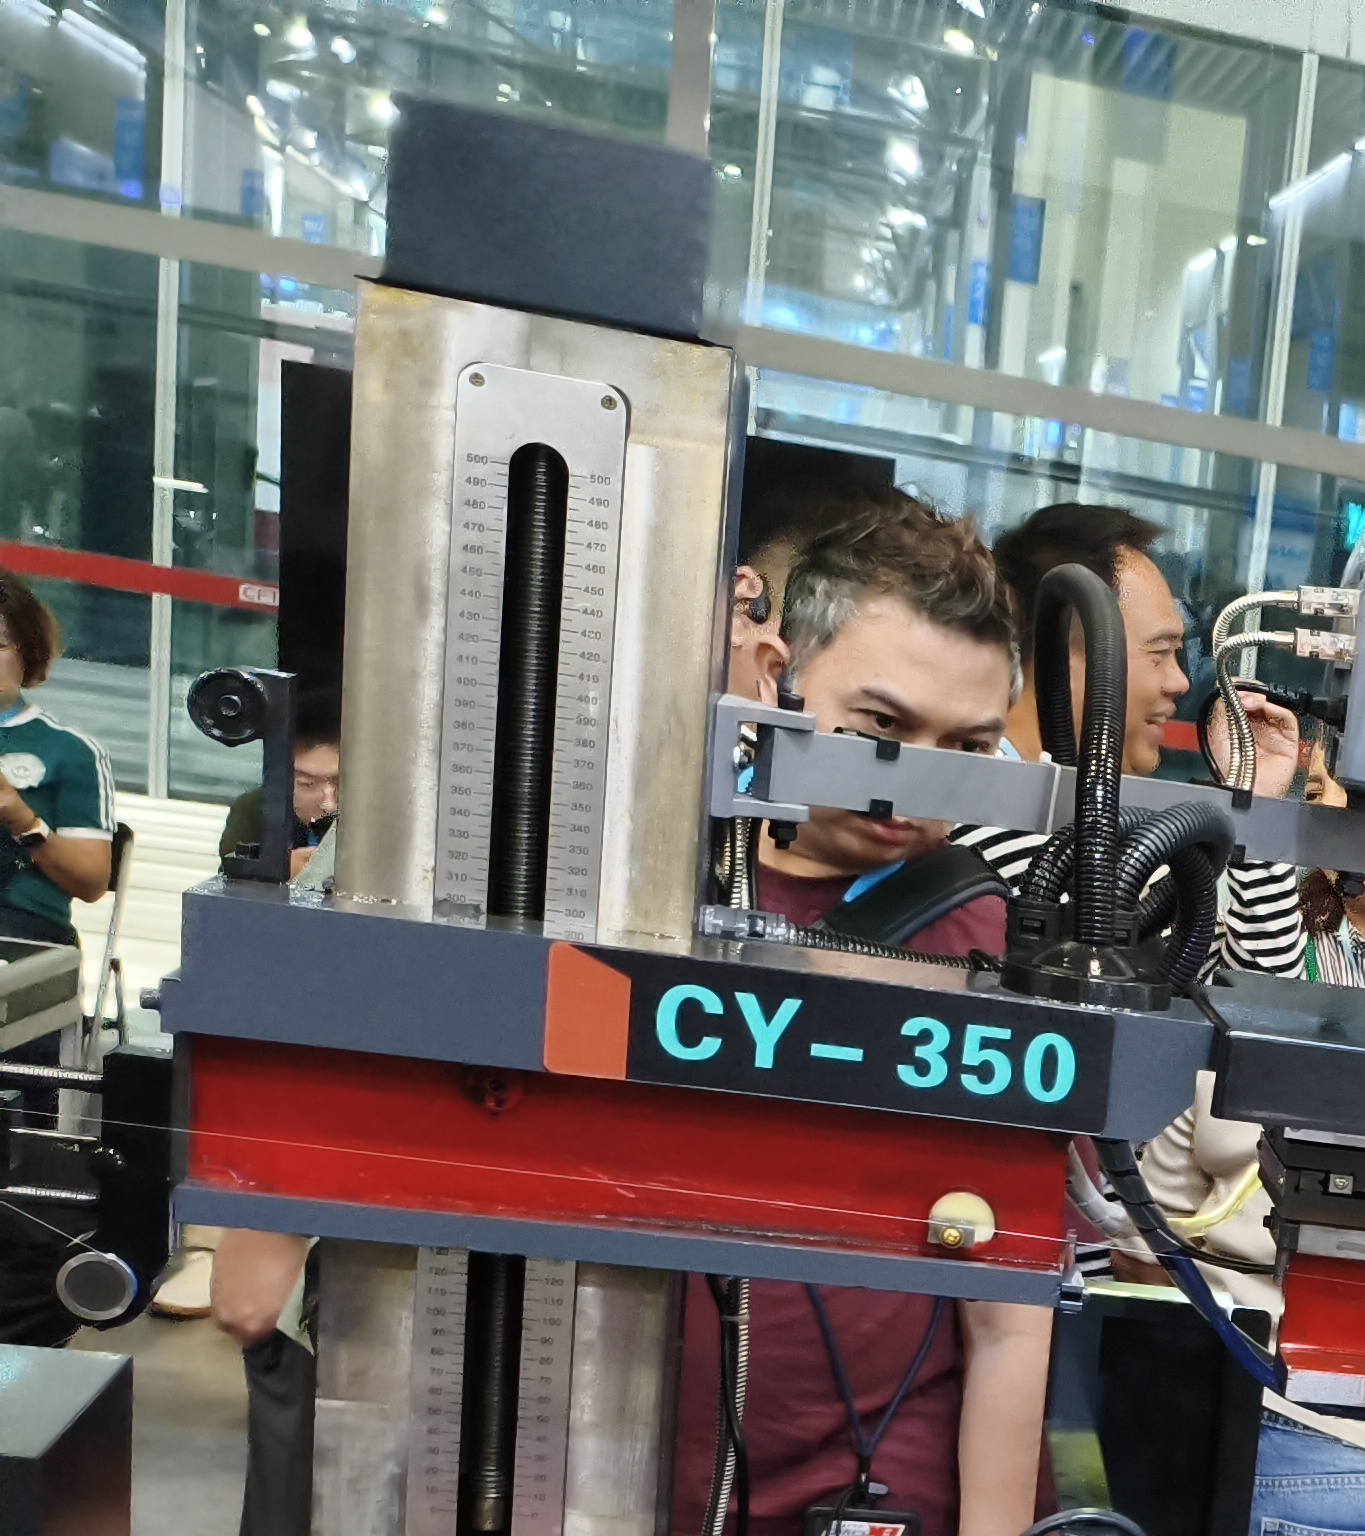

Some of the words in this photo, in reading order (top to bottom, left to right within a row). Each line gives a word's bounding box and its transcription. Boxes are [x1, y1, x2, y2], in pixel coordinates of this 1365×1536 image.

[466, 453, 488, 465] 500
[465, 477, 488, 487] 490
[590, 475, 611, 485] 500
[464, 499, 486, 509] 480
[588, 498, 609, 508] 490
[463, 522, 485, 532] 470
[587, 520, 608, 530] 480
[463, 544, 484, 554] 460
[586, 542, 606, 552] 470
[461, 566, 483, 577] 450
[584, 564, 605, 574] 460
[460, 589, 481, 598] 440
[583, 586, 604, 596] 450
[458, 611, 481, 621] 430
[582, 608, 603, 618] 440
[459, 633, 479, 643] 420
[579, 652, 600, 662] 420
[456, 677, 477, 687] 400
[578, 673, 599, 684] 410
[455, 699, 476, 709] 390
[454, 721, 474, 731] 380
[576, 716, 596, 727] 390
[453, 742, 474, 752] 370
[574, 738, 595, 749] 380
[452, 764, 473, 774] 360
[573, 760, 594, 770] 370
[451, 786, 472, 796] 350
[572, 781, 593, 792] 360
[450, 808, 470, 817] 340
[571, 802, 592, 813] 350
[449, 829, 469, 839] 330
[569, 824, 590, 834] 340
[568, 845, 589, 855] 330
[448, 851, 468, 861] 320
[567, 866, 588, 877] 320
[446, 872, 467, 882] 310
[566, 888, 587, 898] 310
[564, 909, 585, 919] 300
[896, 1016, 1077, 1103] 350
